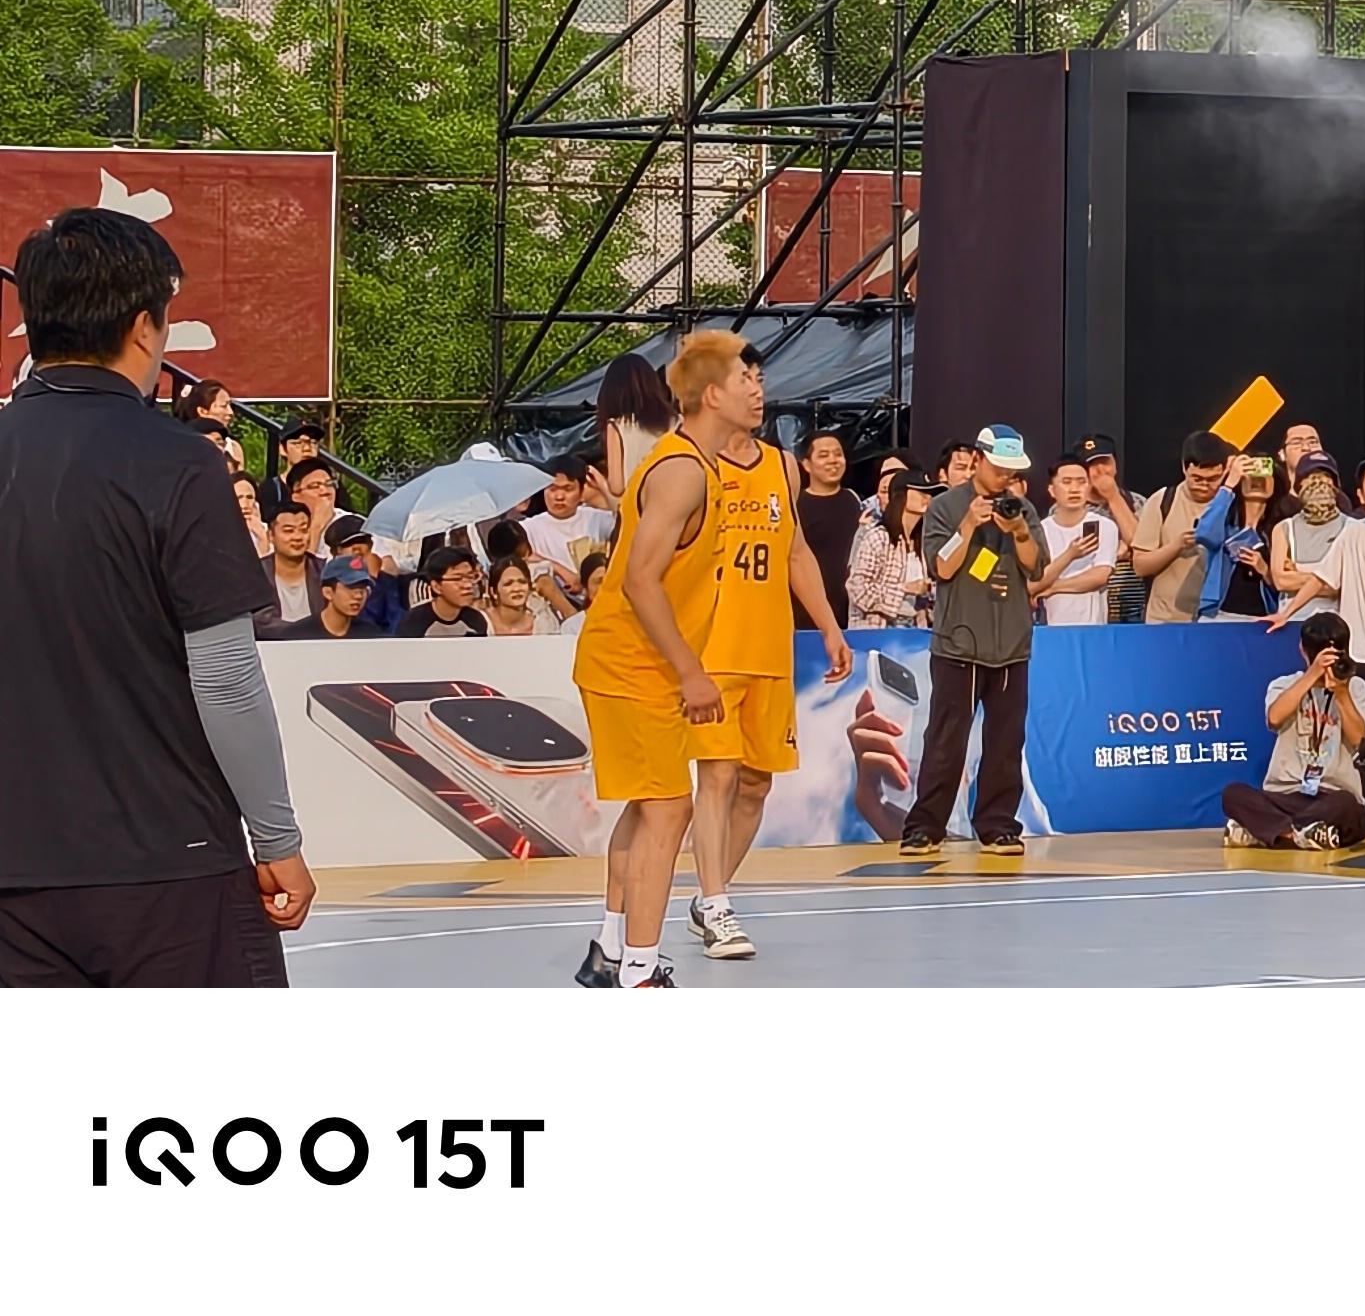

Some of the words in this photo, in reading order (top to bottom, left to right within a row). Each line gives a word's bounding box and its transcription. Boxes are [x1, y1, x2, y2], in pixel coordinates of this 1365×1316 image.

[733, 541, 769, 582] 48
[1107, 710, 1181, 734] iQOO
[1185, 709, 1222, 731] 15T
